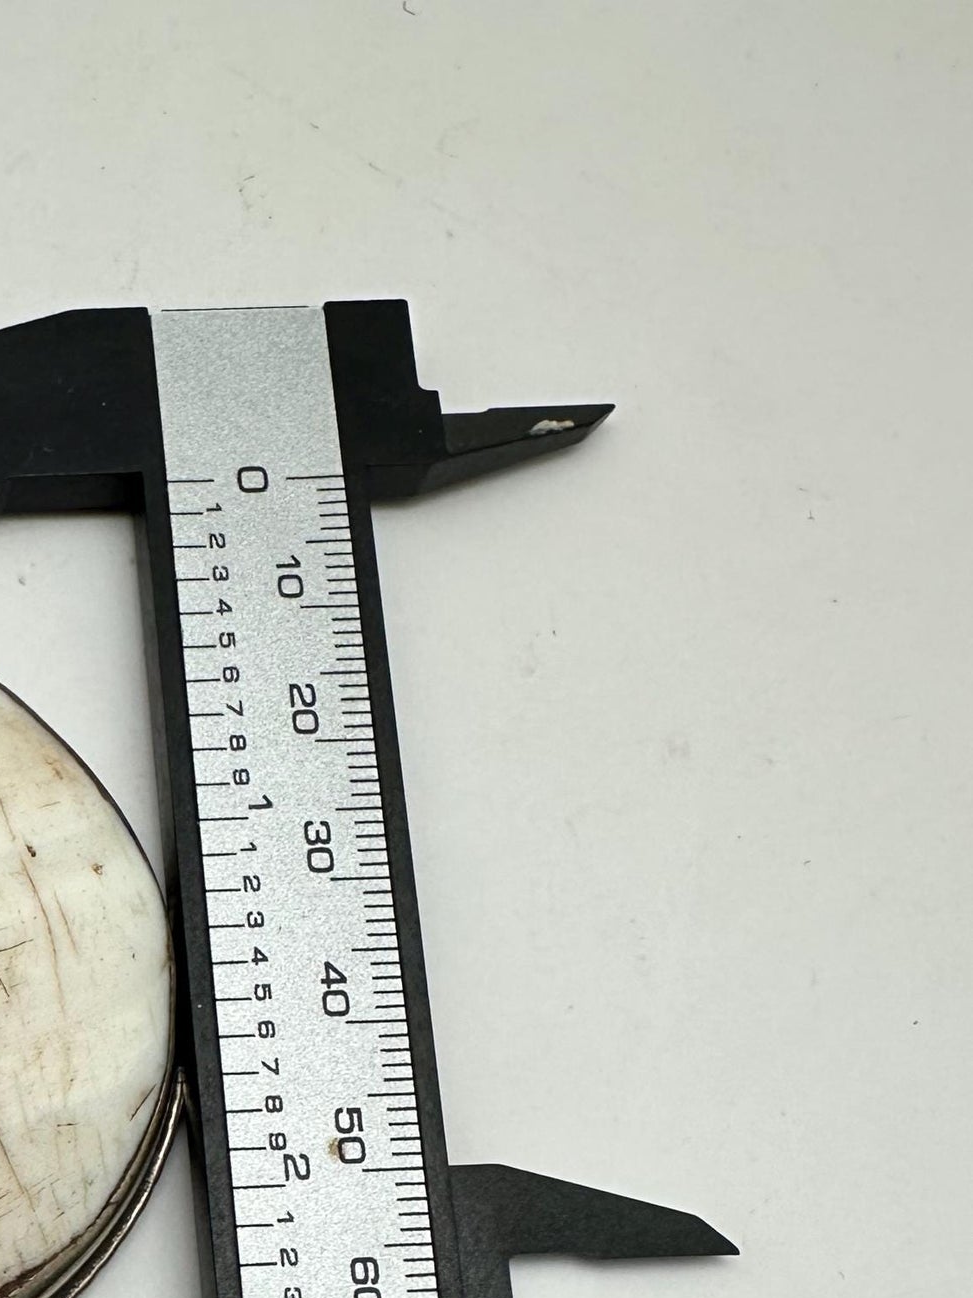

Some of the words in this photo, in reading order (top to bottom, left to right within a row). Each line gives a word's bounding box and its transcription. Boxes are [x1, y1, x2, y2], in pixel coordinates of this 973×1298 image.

[237, 466, 268, 493] 0
[206, 502, 222, 513] 1
[209, 533, 226, 549] 2
[212, 566, 229, 581] 3
[276, 555, 304, 598] 10
[216, 599, 232, 616] 4
[219, 632, 236, 648] 5
[223, 667, 240, 683] 6
[226, 700, 243, 717] 7
[289, 684, 319, 735] 20
[230, 735, 247, 751] 8
[233, 769, 250, 785] 9
[248, 794, 273, 810] 1
[240, 842, 257, 852] 1
[304, 820, 335, 873] 30
[243, 875, 260, 892] 2
[247, 911, 264, 928] 3
[251, 947, 268, 965] 4
[254, 984, 272, 1001] 5
[320, 961, 350, 1017] 40
[258, 1021, 275, 1039] 6
[261, 1058, 279, 1075] 7
[265, 1095, 283, 1113] 8
[269, 1132, 286, 1150] 9
[335, 1107, 366, 1164] 50
[283, 1153, 310, 1181] 2
[277, 1211, 294, 1223] 1
[280, 1248, 298, 1266] 2
